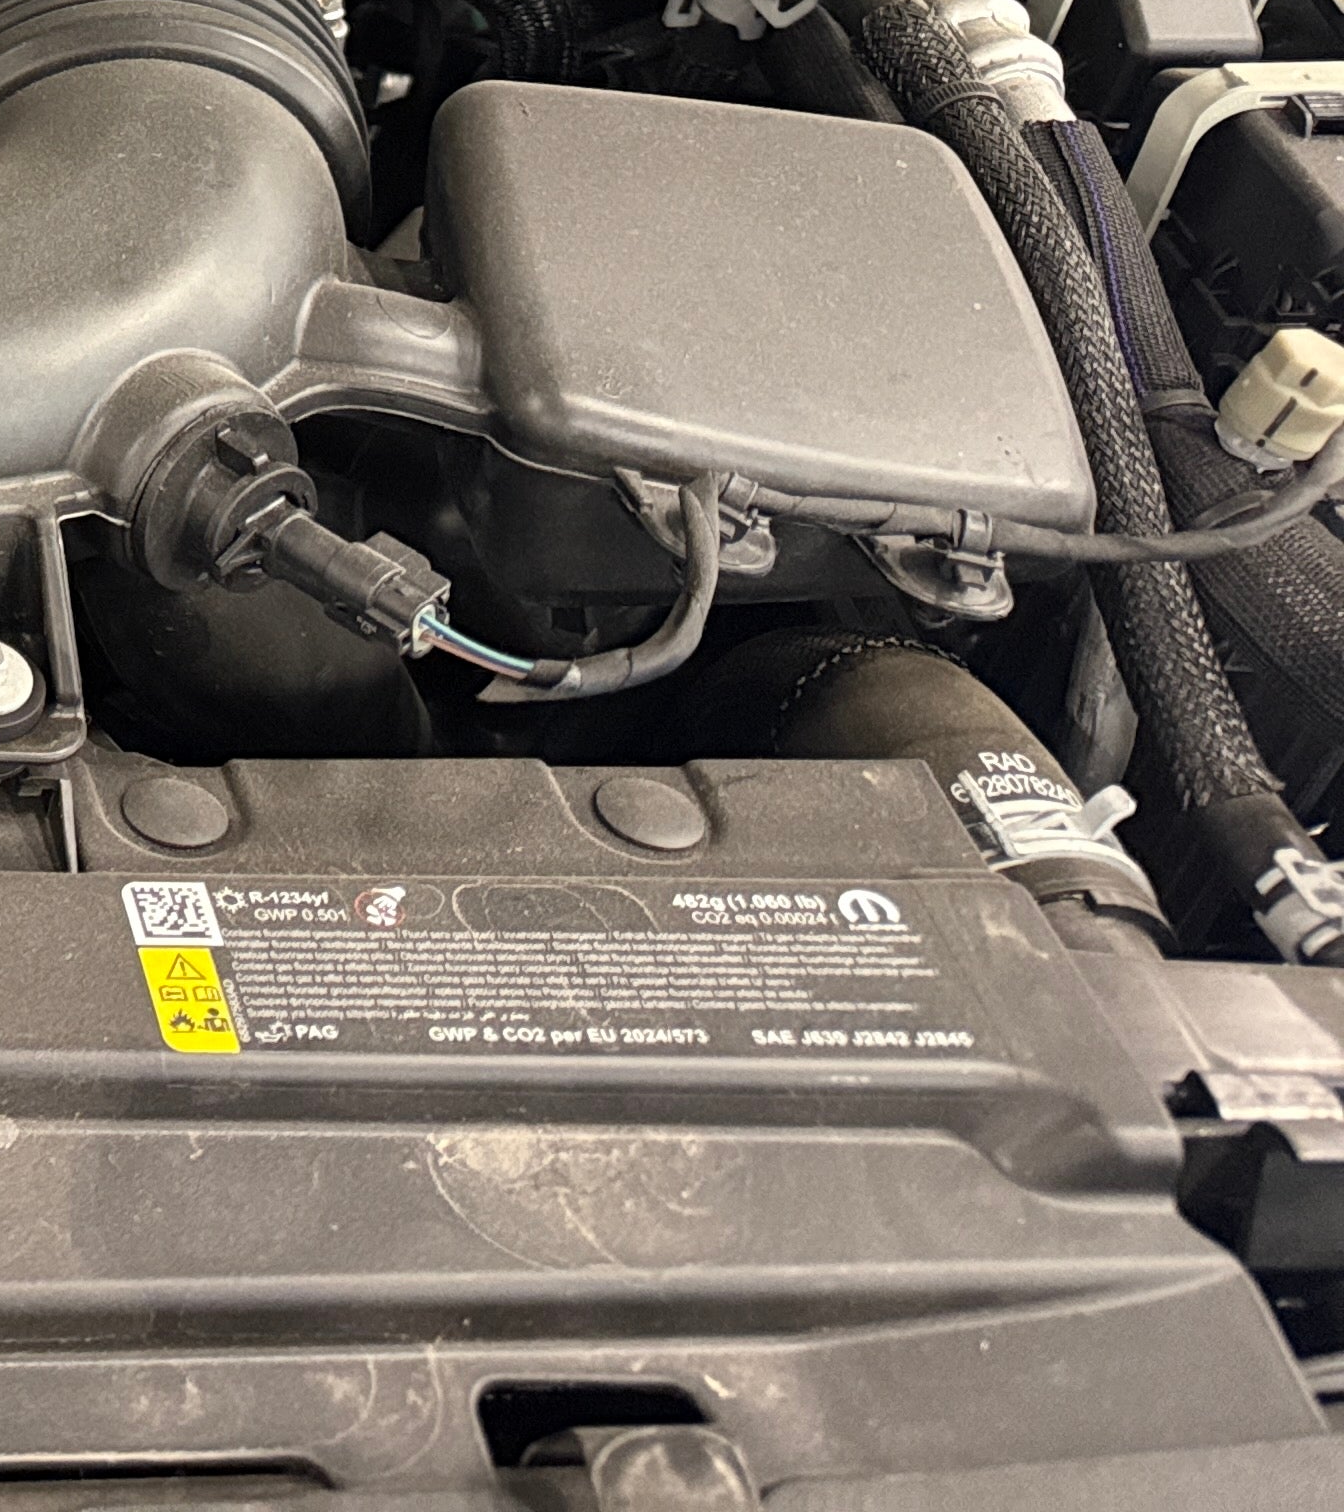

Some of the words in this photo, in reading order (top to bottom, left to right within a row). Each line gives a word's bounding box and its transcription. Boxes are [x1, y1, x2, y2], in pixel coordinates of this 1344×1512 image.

[978, 752, 1036, 773] RAD
[950, 773, 1084, 809] 6280782AD
[248, 891, 329, 906] R-1234yf
[794, 894, 827, 913] lb)
[254, 909, 297, 922] GWP
[301, 909, 348, 922] 0.501
[691, 910, 732, 925] CO2
[735, 914, 759, 928] eq
[295, 1025, 339, 1040] PAG
[428, 1026, 477, 1042] GWP
[482, 1027, 499, 1042] &
[502, 1026, 546, 1042] CO2
[550, 1029, 583, 1046] per
[586, 1027, 618, 1043] EU
[750, 1029, 798, 1046] SAE
